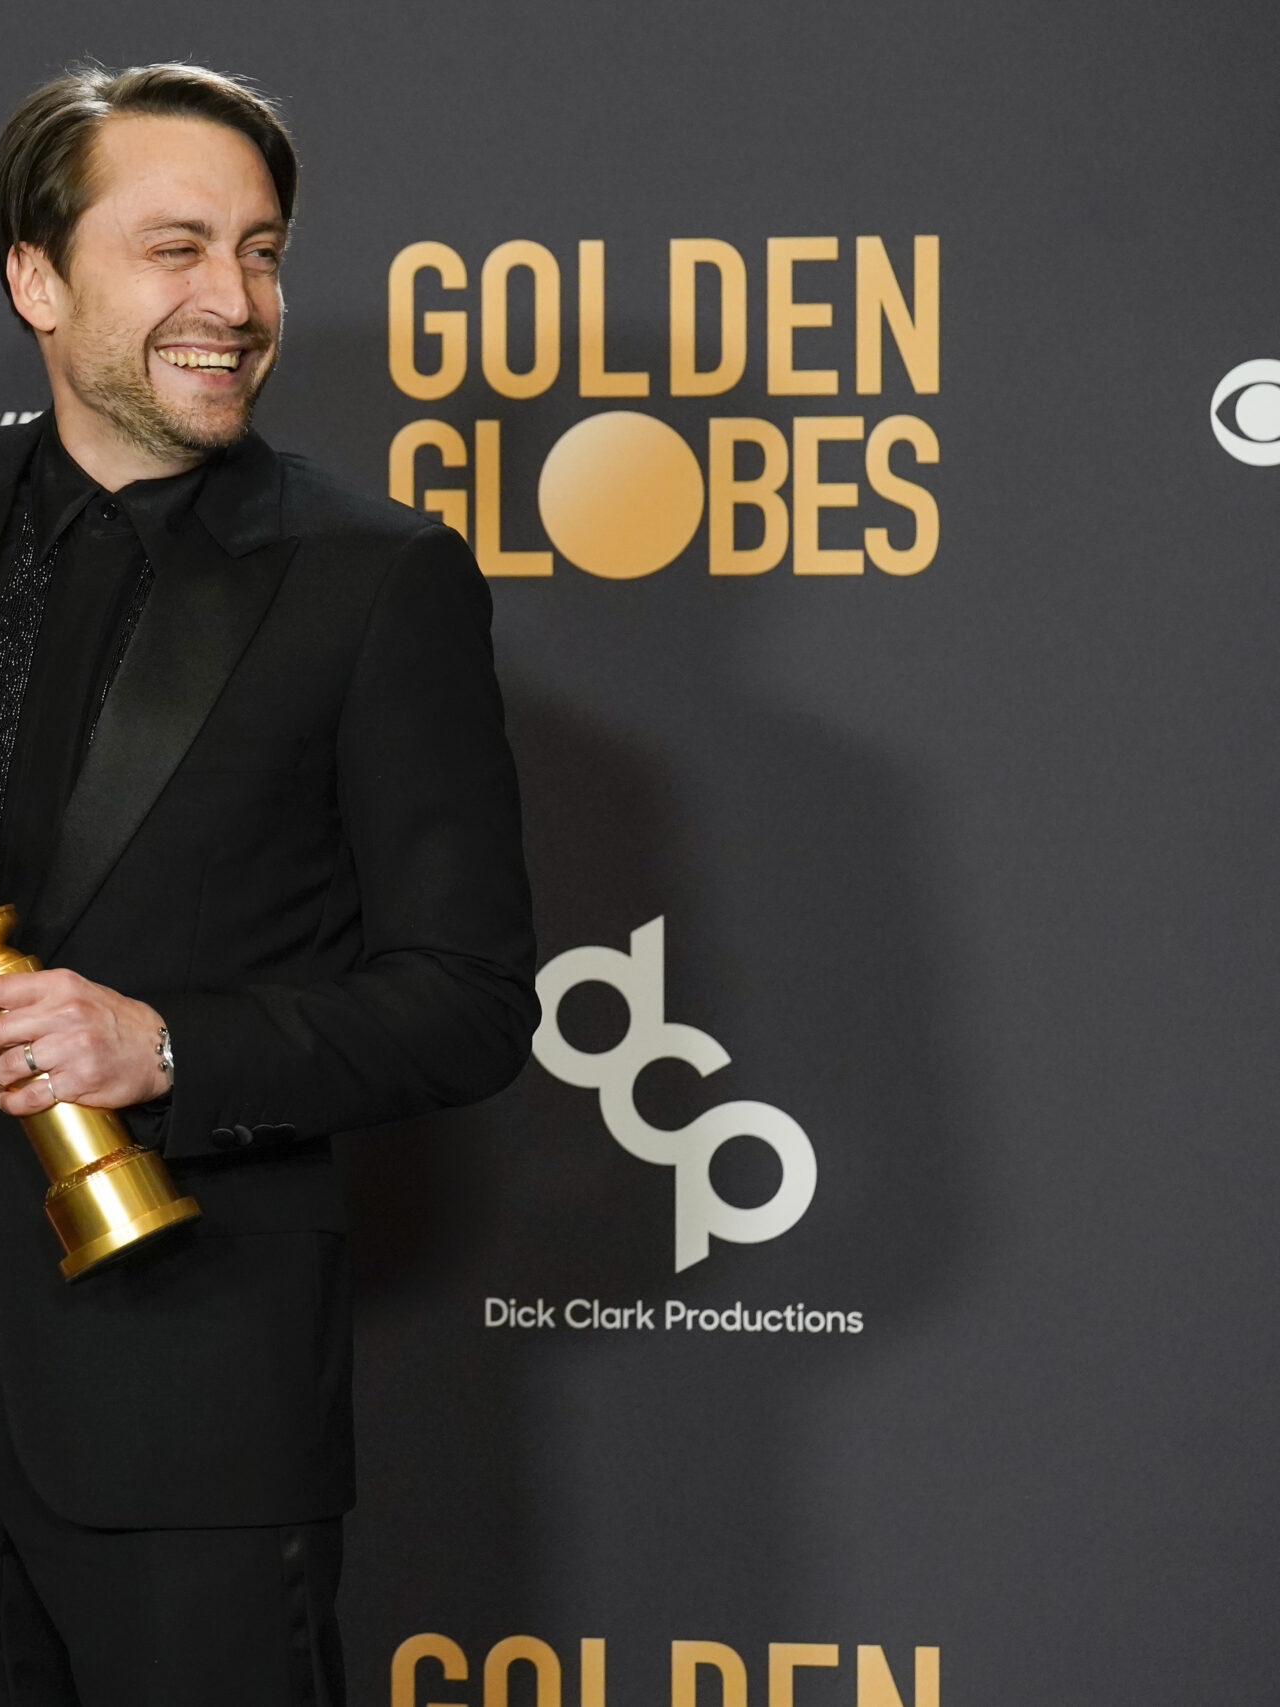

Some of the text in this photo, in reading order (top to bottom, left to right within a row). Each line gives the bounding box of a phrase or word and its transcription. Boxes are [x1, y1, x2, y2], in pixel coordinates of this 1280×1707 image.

[388, 234, 940, 401] GOLDEN
[388, 410, 940, 580] GLOBES
[484, 1298, 864, 1334] Dick Clark Productions
